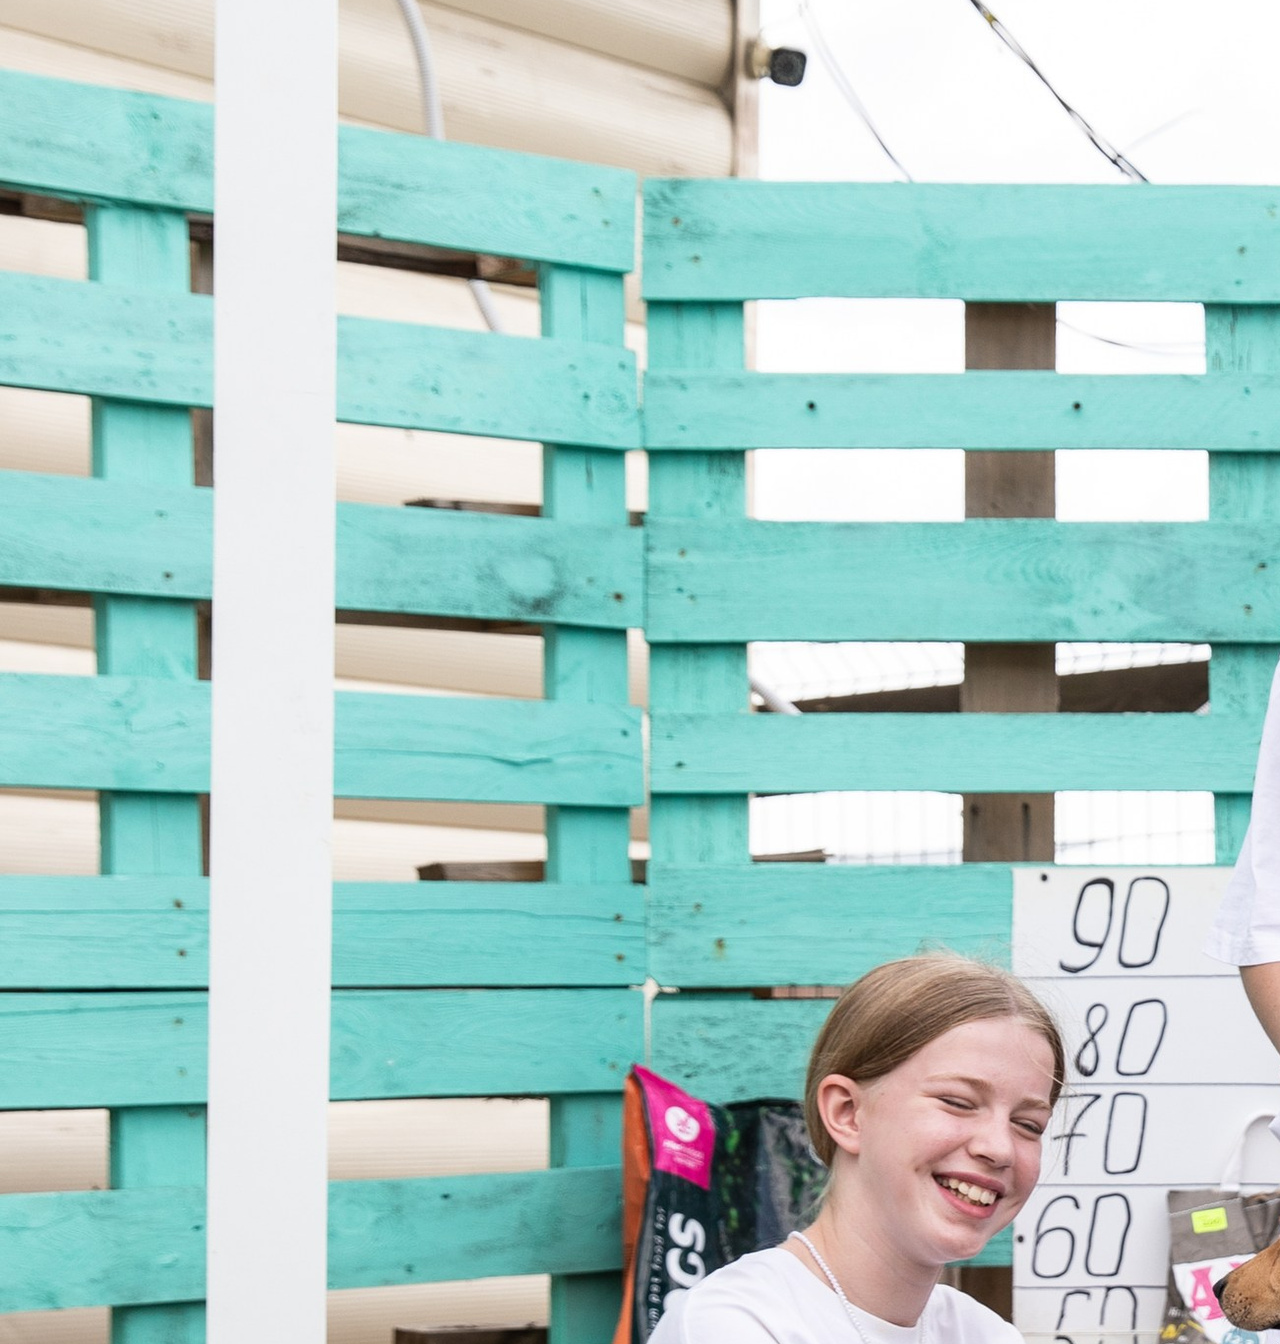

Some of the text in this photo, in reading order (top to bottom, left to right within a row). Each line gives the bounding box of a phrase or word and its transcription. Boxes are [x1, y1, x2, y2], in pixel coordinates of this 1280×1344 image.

[1059, 876, 1170, 973] 90
[1074, 998, 1168, 1077] 80
[1053, 1091, 1148, 1176] 70
[1031, 1192, 1132, 1279] 60
